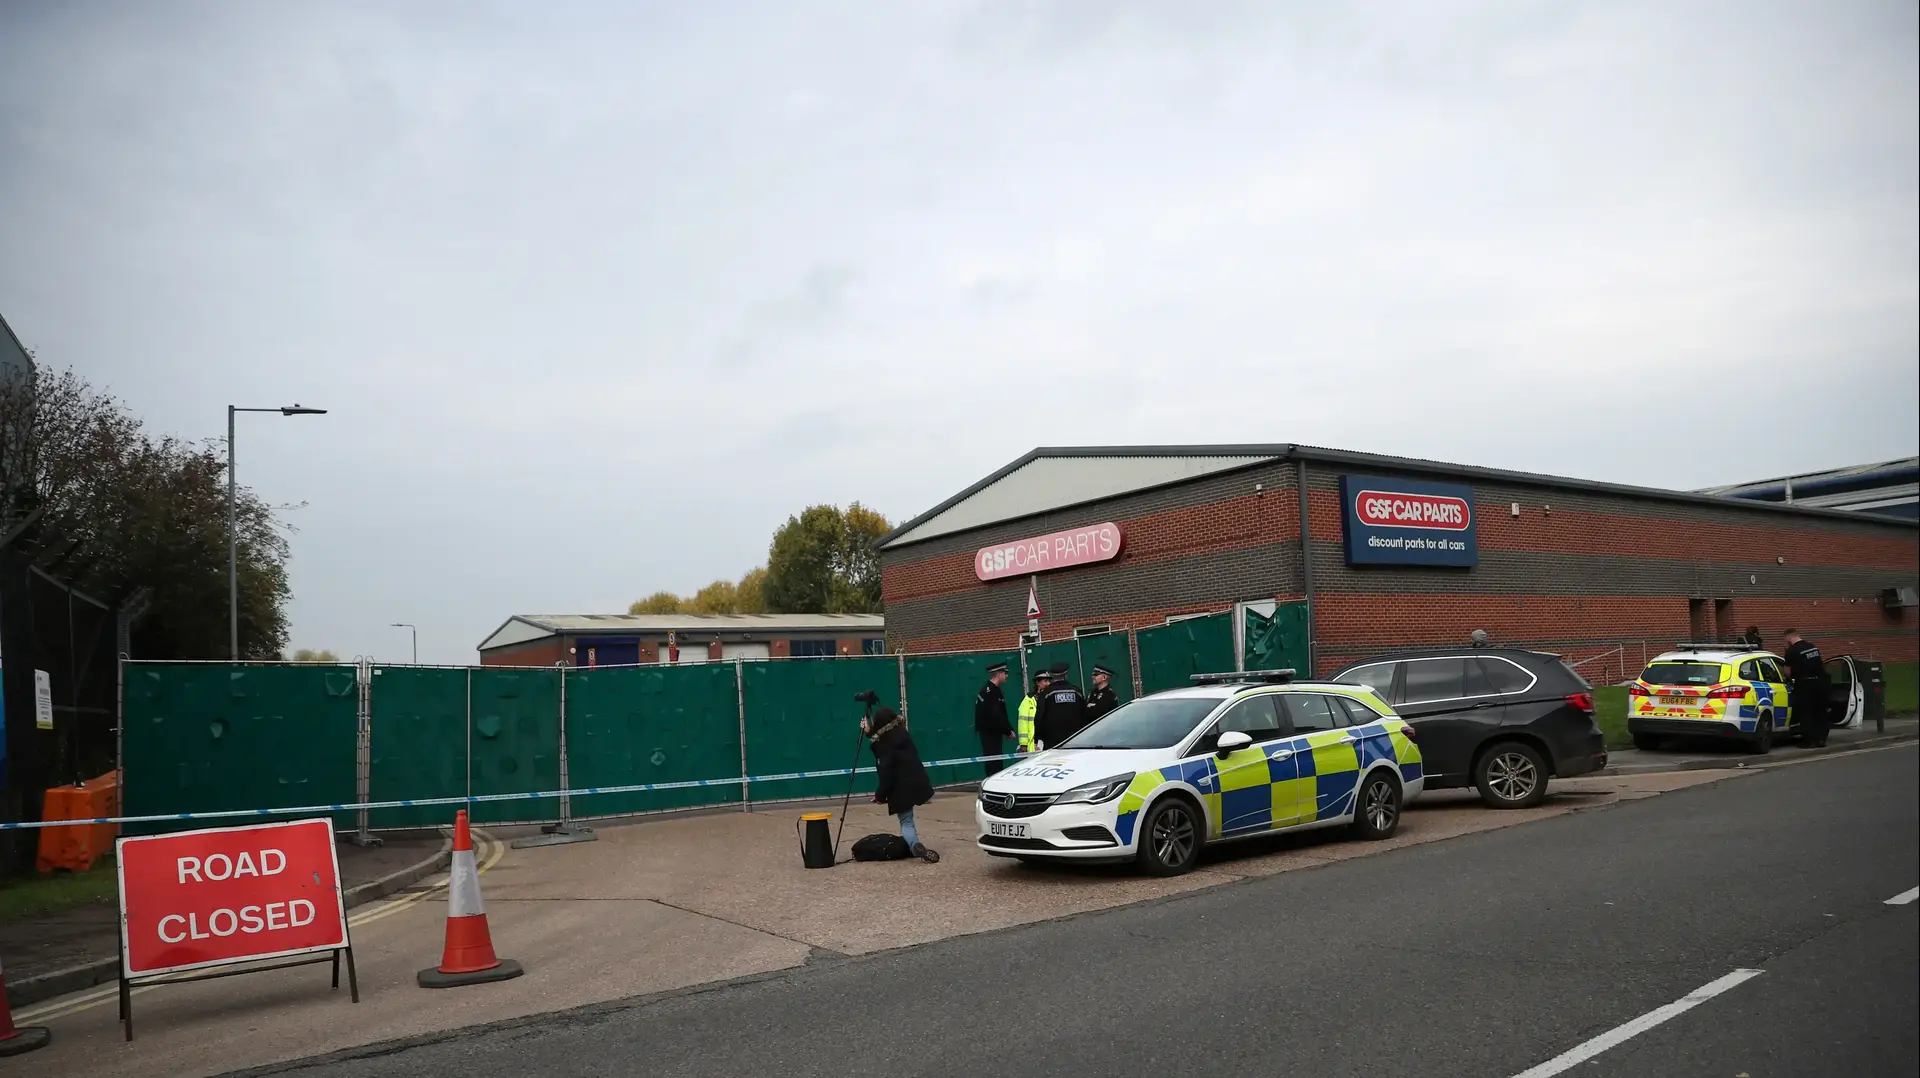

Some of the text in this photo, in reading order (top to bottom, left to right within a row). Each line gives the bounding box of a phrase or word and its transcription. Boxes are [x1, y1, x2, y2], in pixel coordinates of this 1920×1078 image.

[1365, 498, 1463, 524] GSF CAR PARTS
[1055, 528, 1113, 561] PARTS
[1368, 536, 1466, 551] discount parts for all cars
[1056, 693, 1075, 702] POLICE
[1641, 711, 1713, 719] POLICE
[1000, 766, 1075, 780] POLICE
[991, 823, 1025, 837] EU17 EJZ
[177, 848, 287, 884] ROAD
[157, 899, 316, 943] CLOSED
